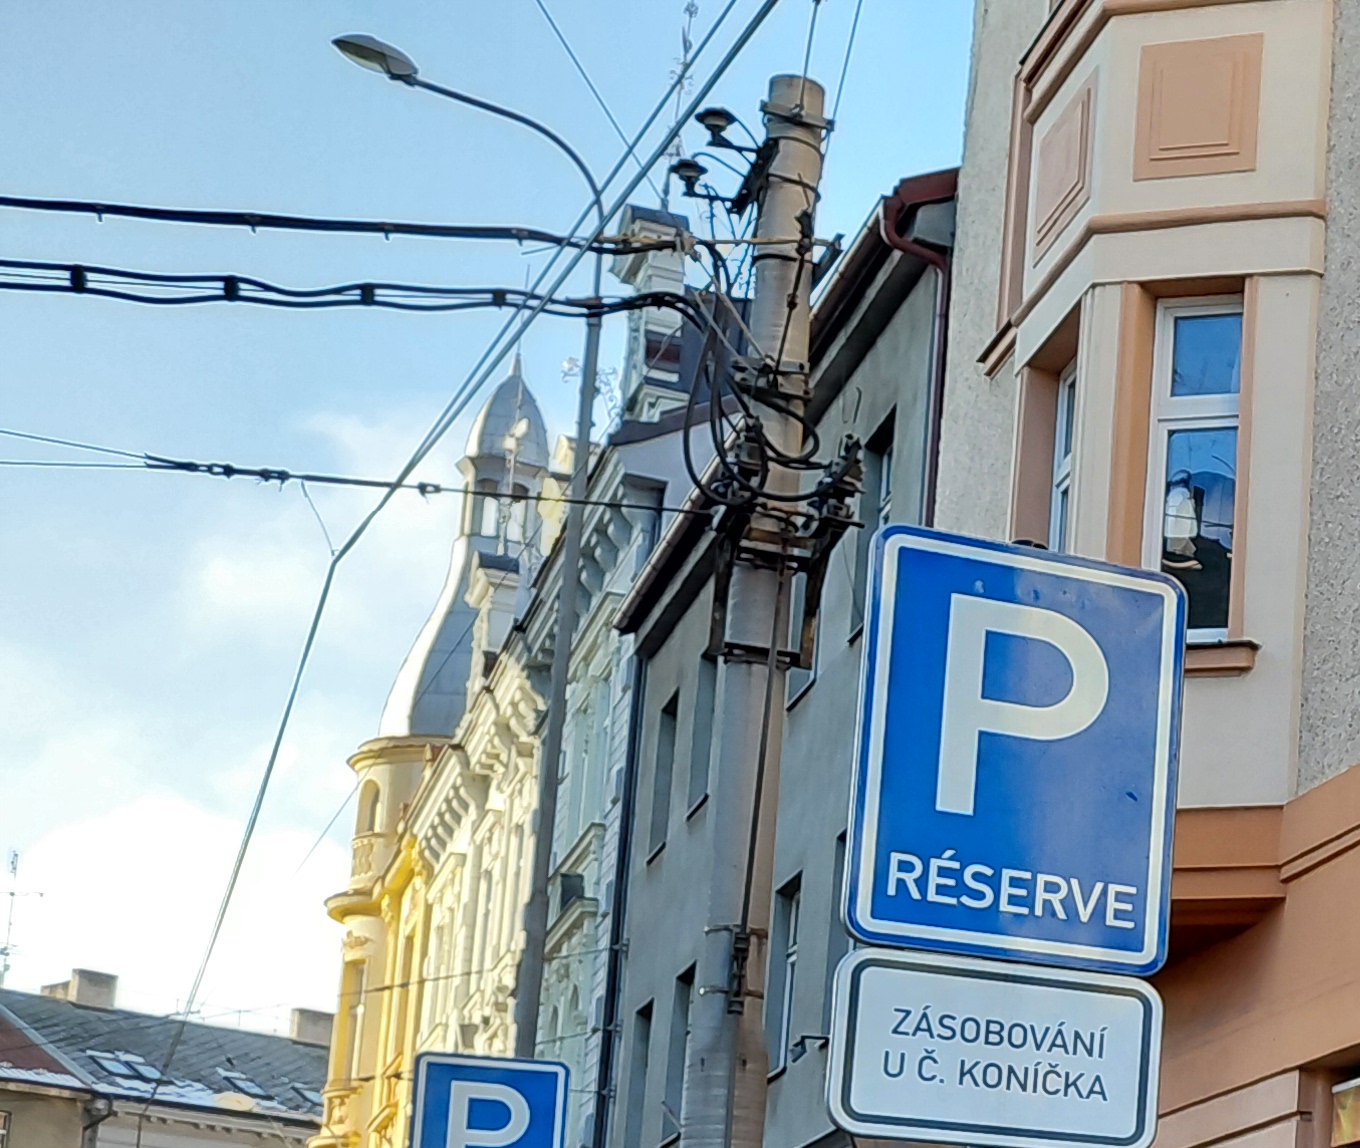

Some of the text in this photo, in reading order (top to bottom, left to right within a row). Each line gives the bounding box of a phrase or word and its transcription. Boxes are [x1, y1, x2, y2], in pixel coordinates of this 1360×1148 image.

[936, 592, 1109, 816] P
[887, 850, 1138, 930] RÉSERVE
[891, 1004, 1109, 1060] ZÁSOBOVÁNÍ
[883, 1050, 1109, 1103] U Č. KONÍČKA
